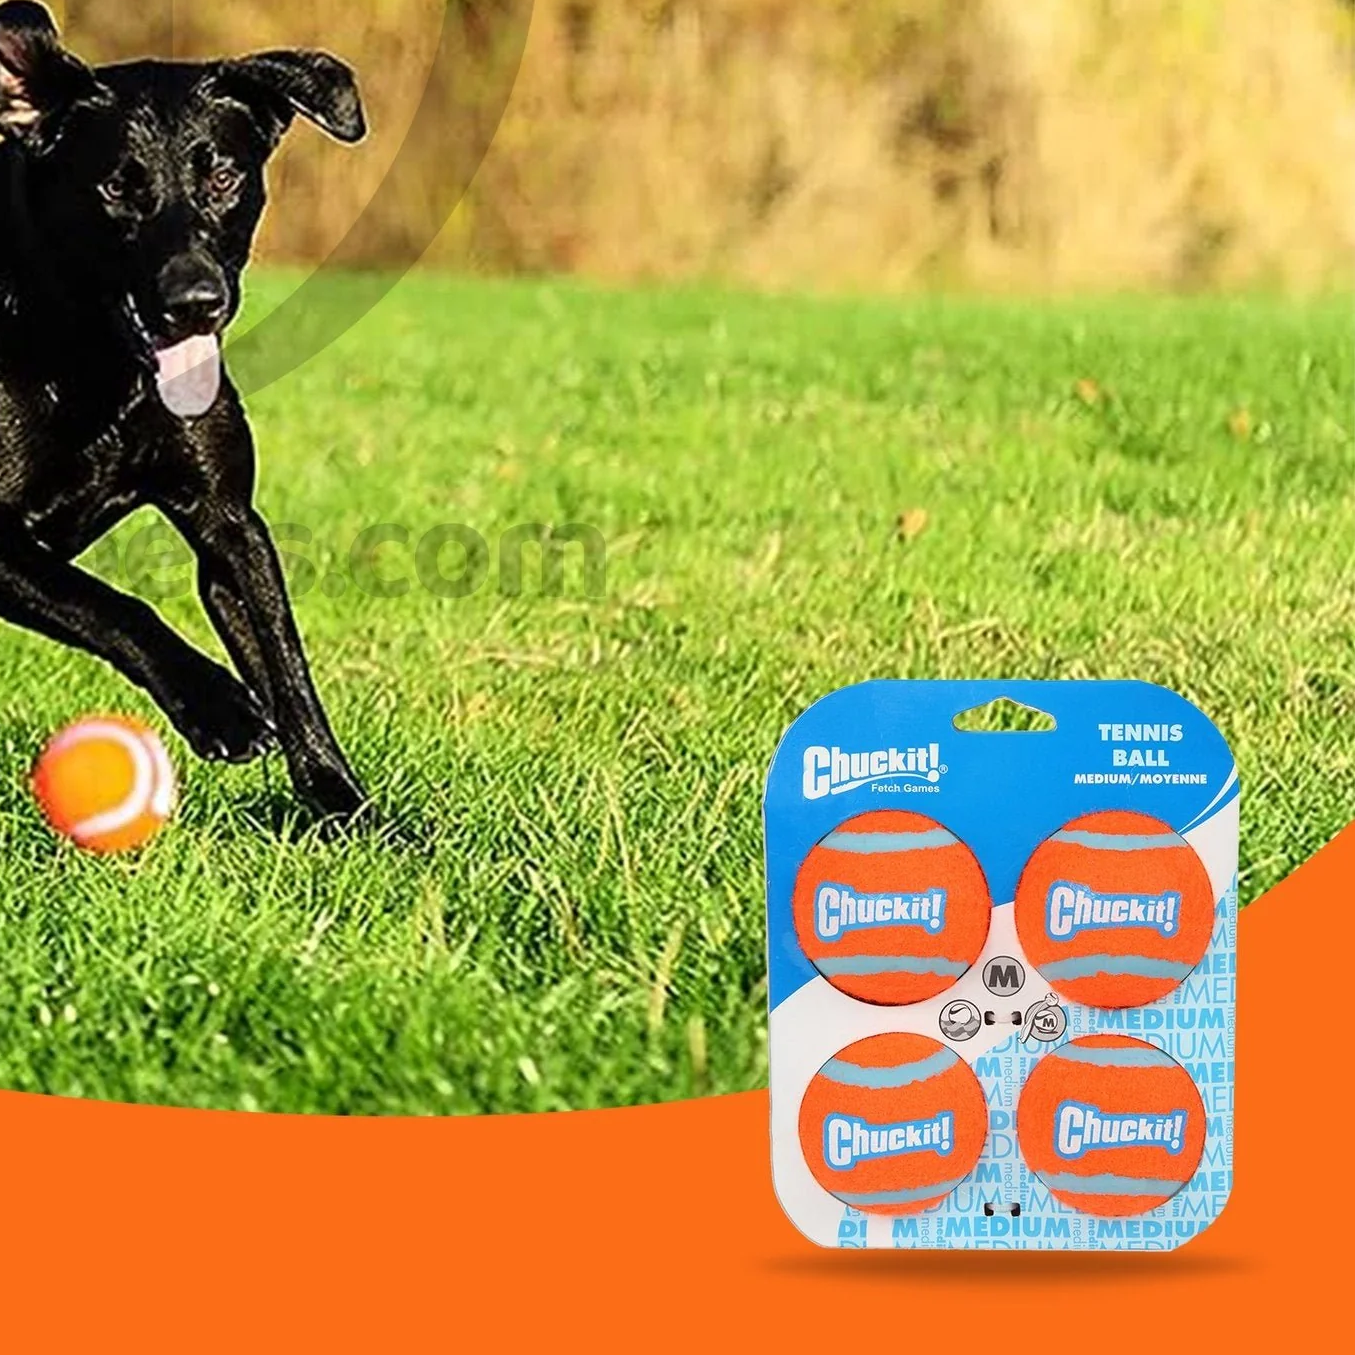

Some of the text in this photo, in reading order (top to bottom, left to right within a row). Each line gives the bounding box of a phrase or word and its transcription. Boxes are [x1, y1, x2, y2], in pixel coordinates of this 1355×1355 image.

[1098, 724, 1183, 742] TENNIS
[1112, 749, 1170, 767] BALL
[871, 784, 940, 793] Fetch Games
[1074, 773, 1207, 786] MEDIUM/MOYENNE
[818, 887, 942, 937] Chuckit!
[1050, 886, 1175, 936] Chuckit!
[988, 965, 1020, 988] M
[1097, 1008, 1225, 1030] MEDIUM
[828, 1116, 950, 1166] Chuckit!
[1058, 1106, 1183, 1154] Chuckit!
[945, 1217, 1071, 1238] MEDIUM
